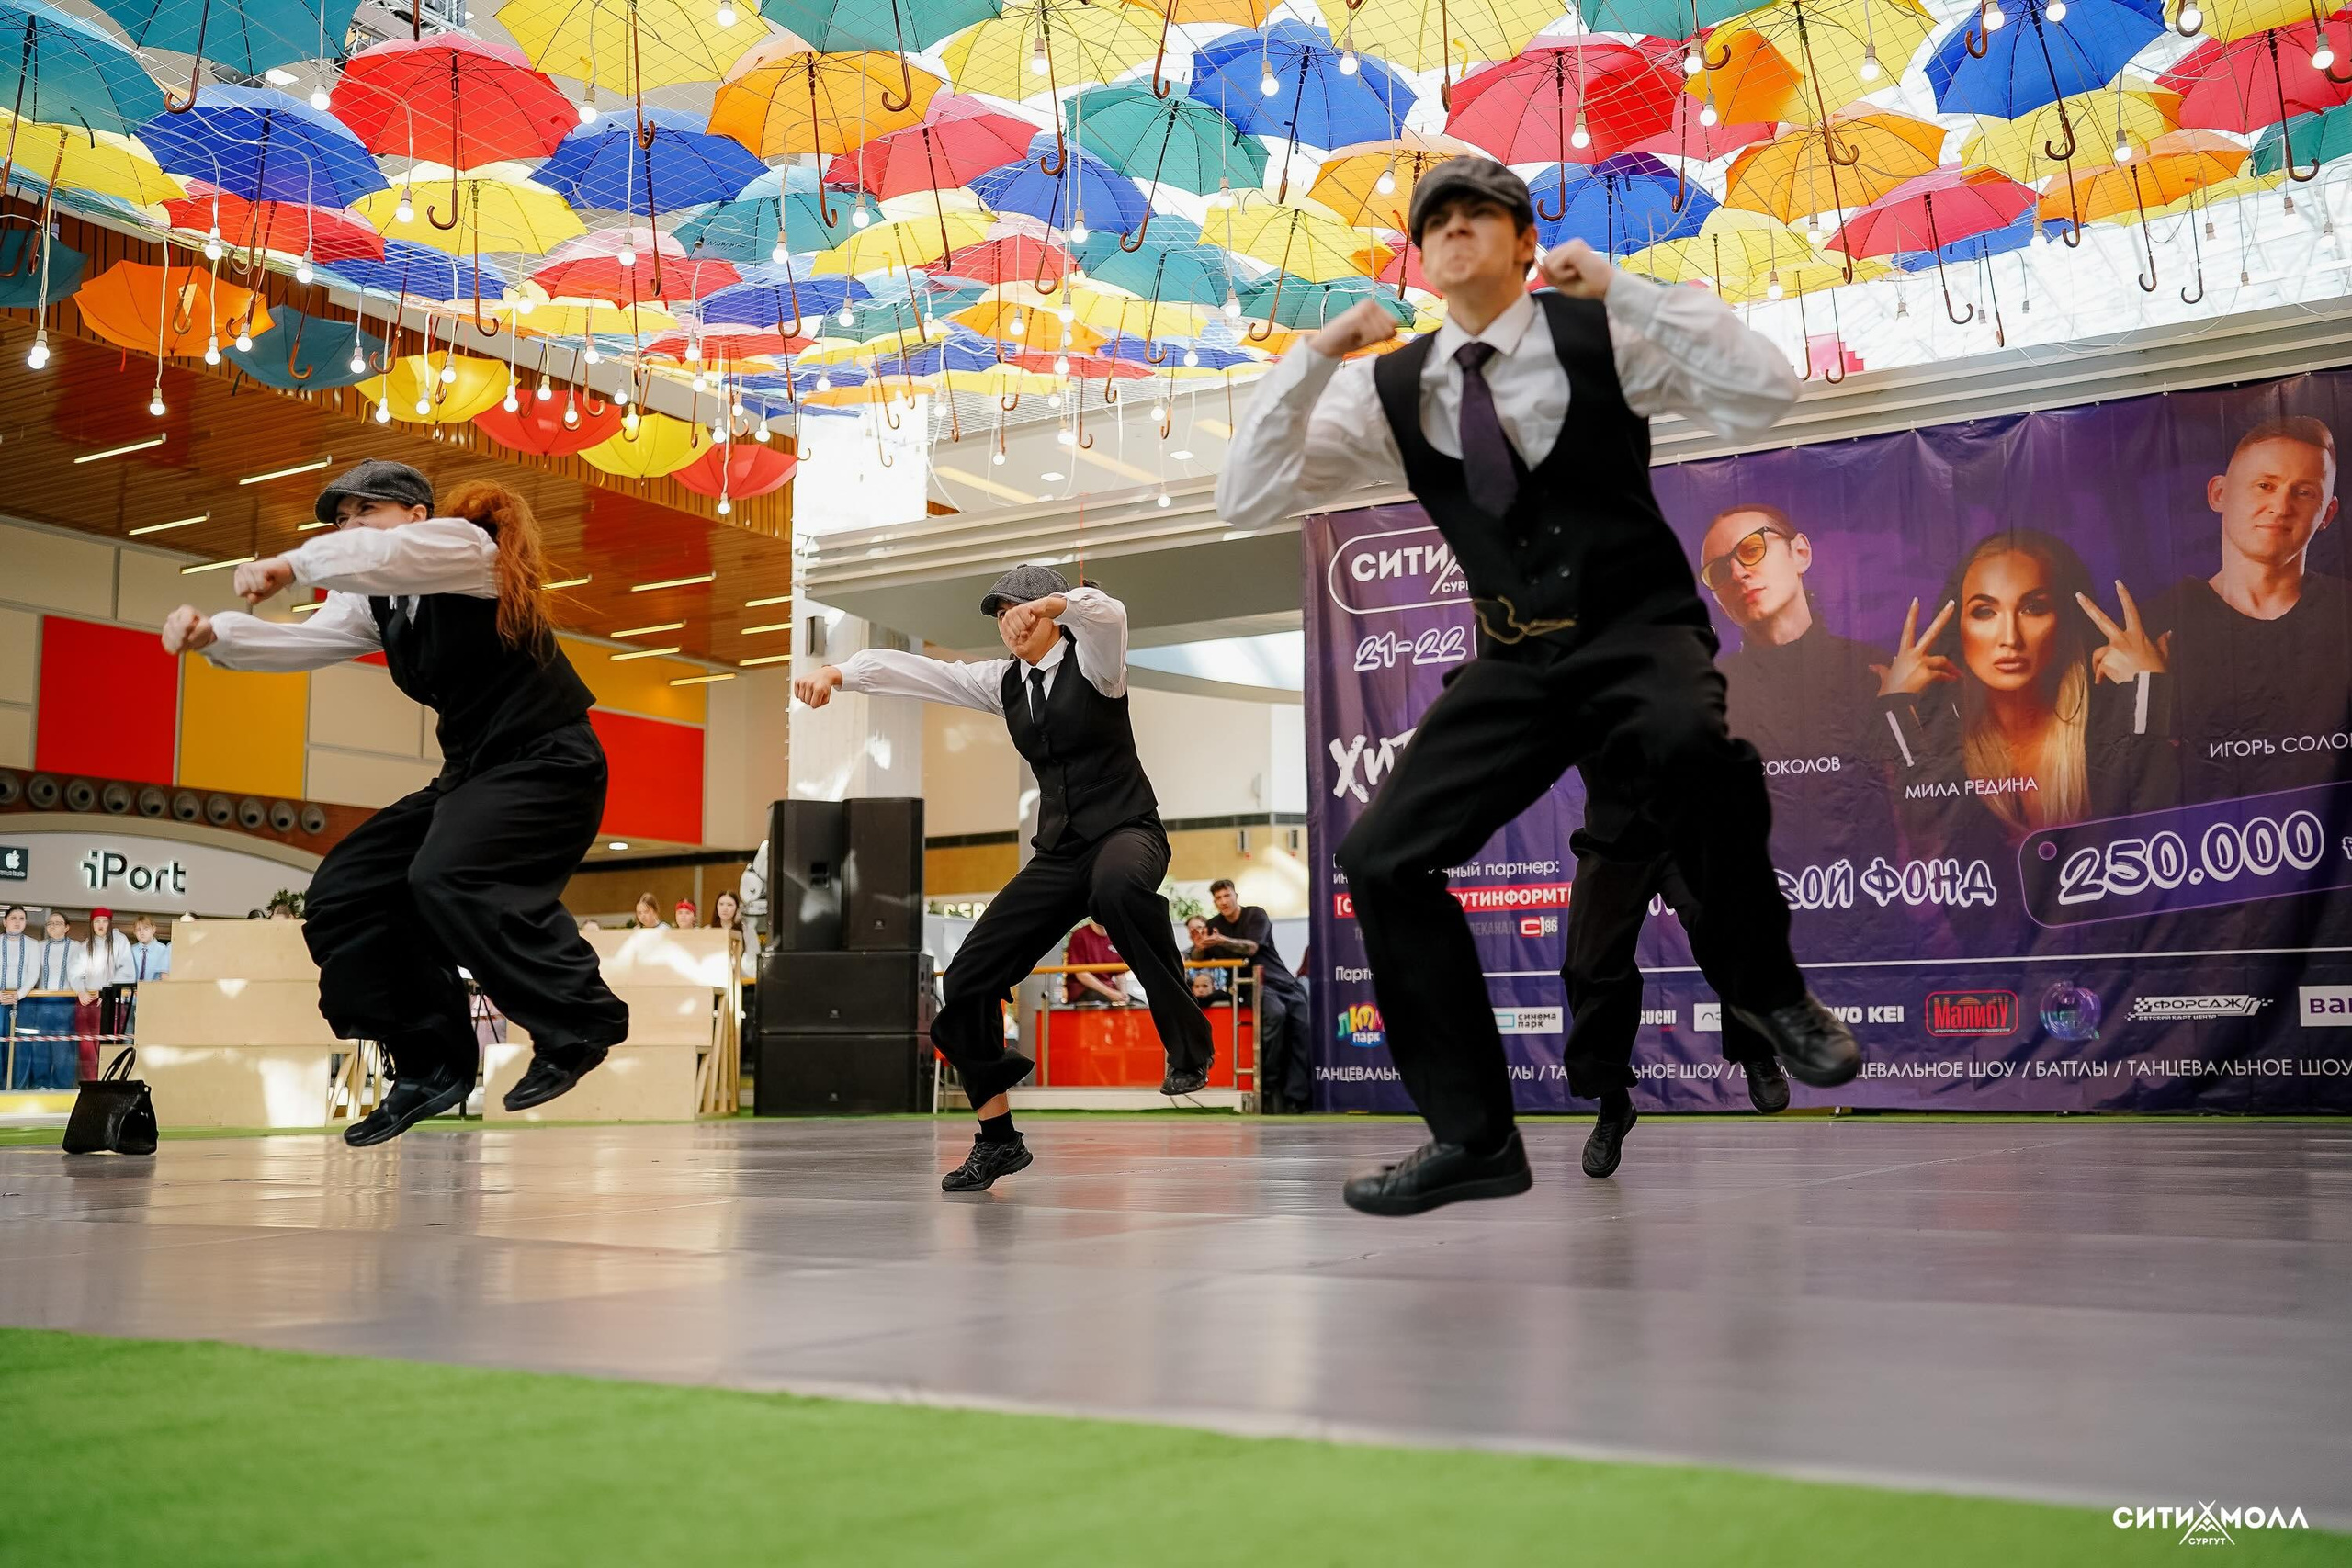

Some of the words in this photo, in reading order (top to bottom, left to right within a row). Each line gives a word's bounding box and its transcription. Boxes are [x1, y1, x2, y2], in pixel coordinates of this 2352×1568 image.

[1351, 543, 1449, 582] СИТИ
[1353, 625, 1467, 672] 21-22
[2210, 739, 2276, 758] ИГОРЬ
[2281, 732, 2352, 753] СОЛО
[1905, 782, 1961, 800] МИЛА
[1964, 776, 2039, 796] РЕДИНА
[1485, 860, 1560, 879] партнер:
[2058, 809, 2324, 906] 250.000
[80, 848, 187, 896] iPort
[1860, 856, 1997, 908] ФОНД
[1868, 1005, 1905, 1023] KEI
[2154, 998, 2244, 1010] ФОРСАЖ
[1518, 1021, 1544, 1030] парк
[1679, 1063, 1724, 1079] ШОУ
[1969, 1060, 2017, 1078] ШОУ
[2036, 1060, 2108, 1077] БАТТЛЫ
[2127, 1058, 2294, 1078] ТАНЦЕВАЛЬНОЕ
[2300, 1058, 2352, 1077] ШОУ
